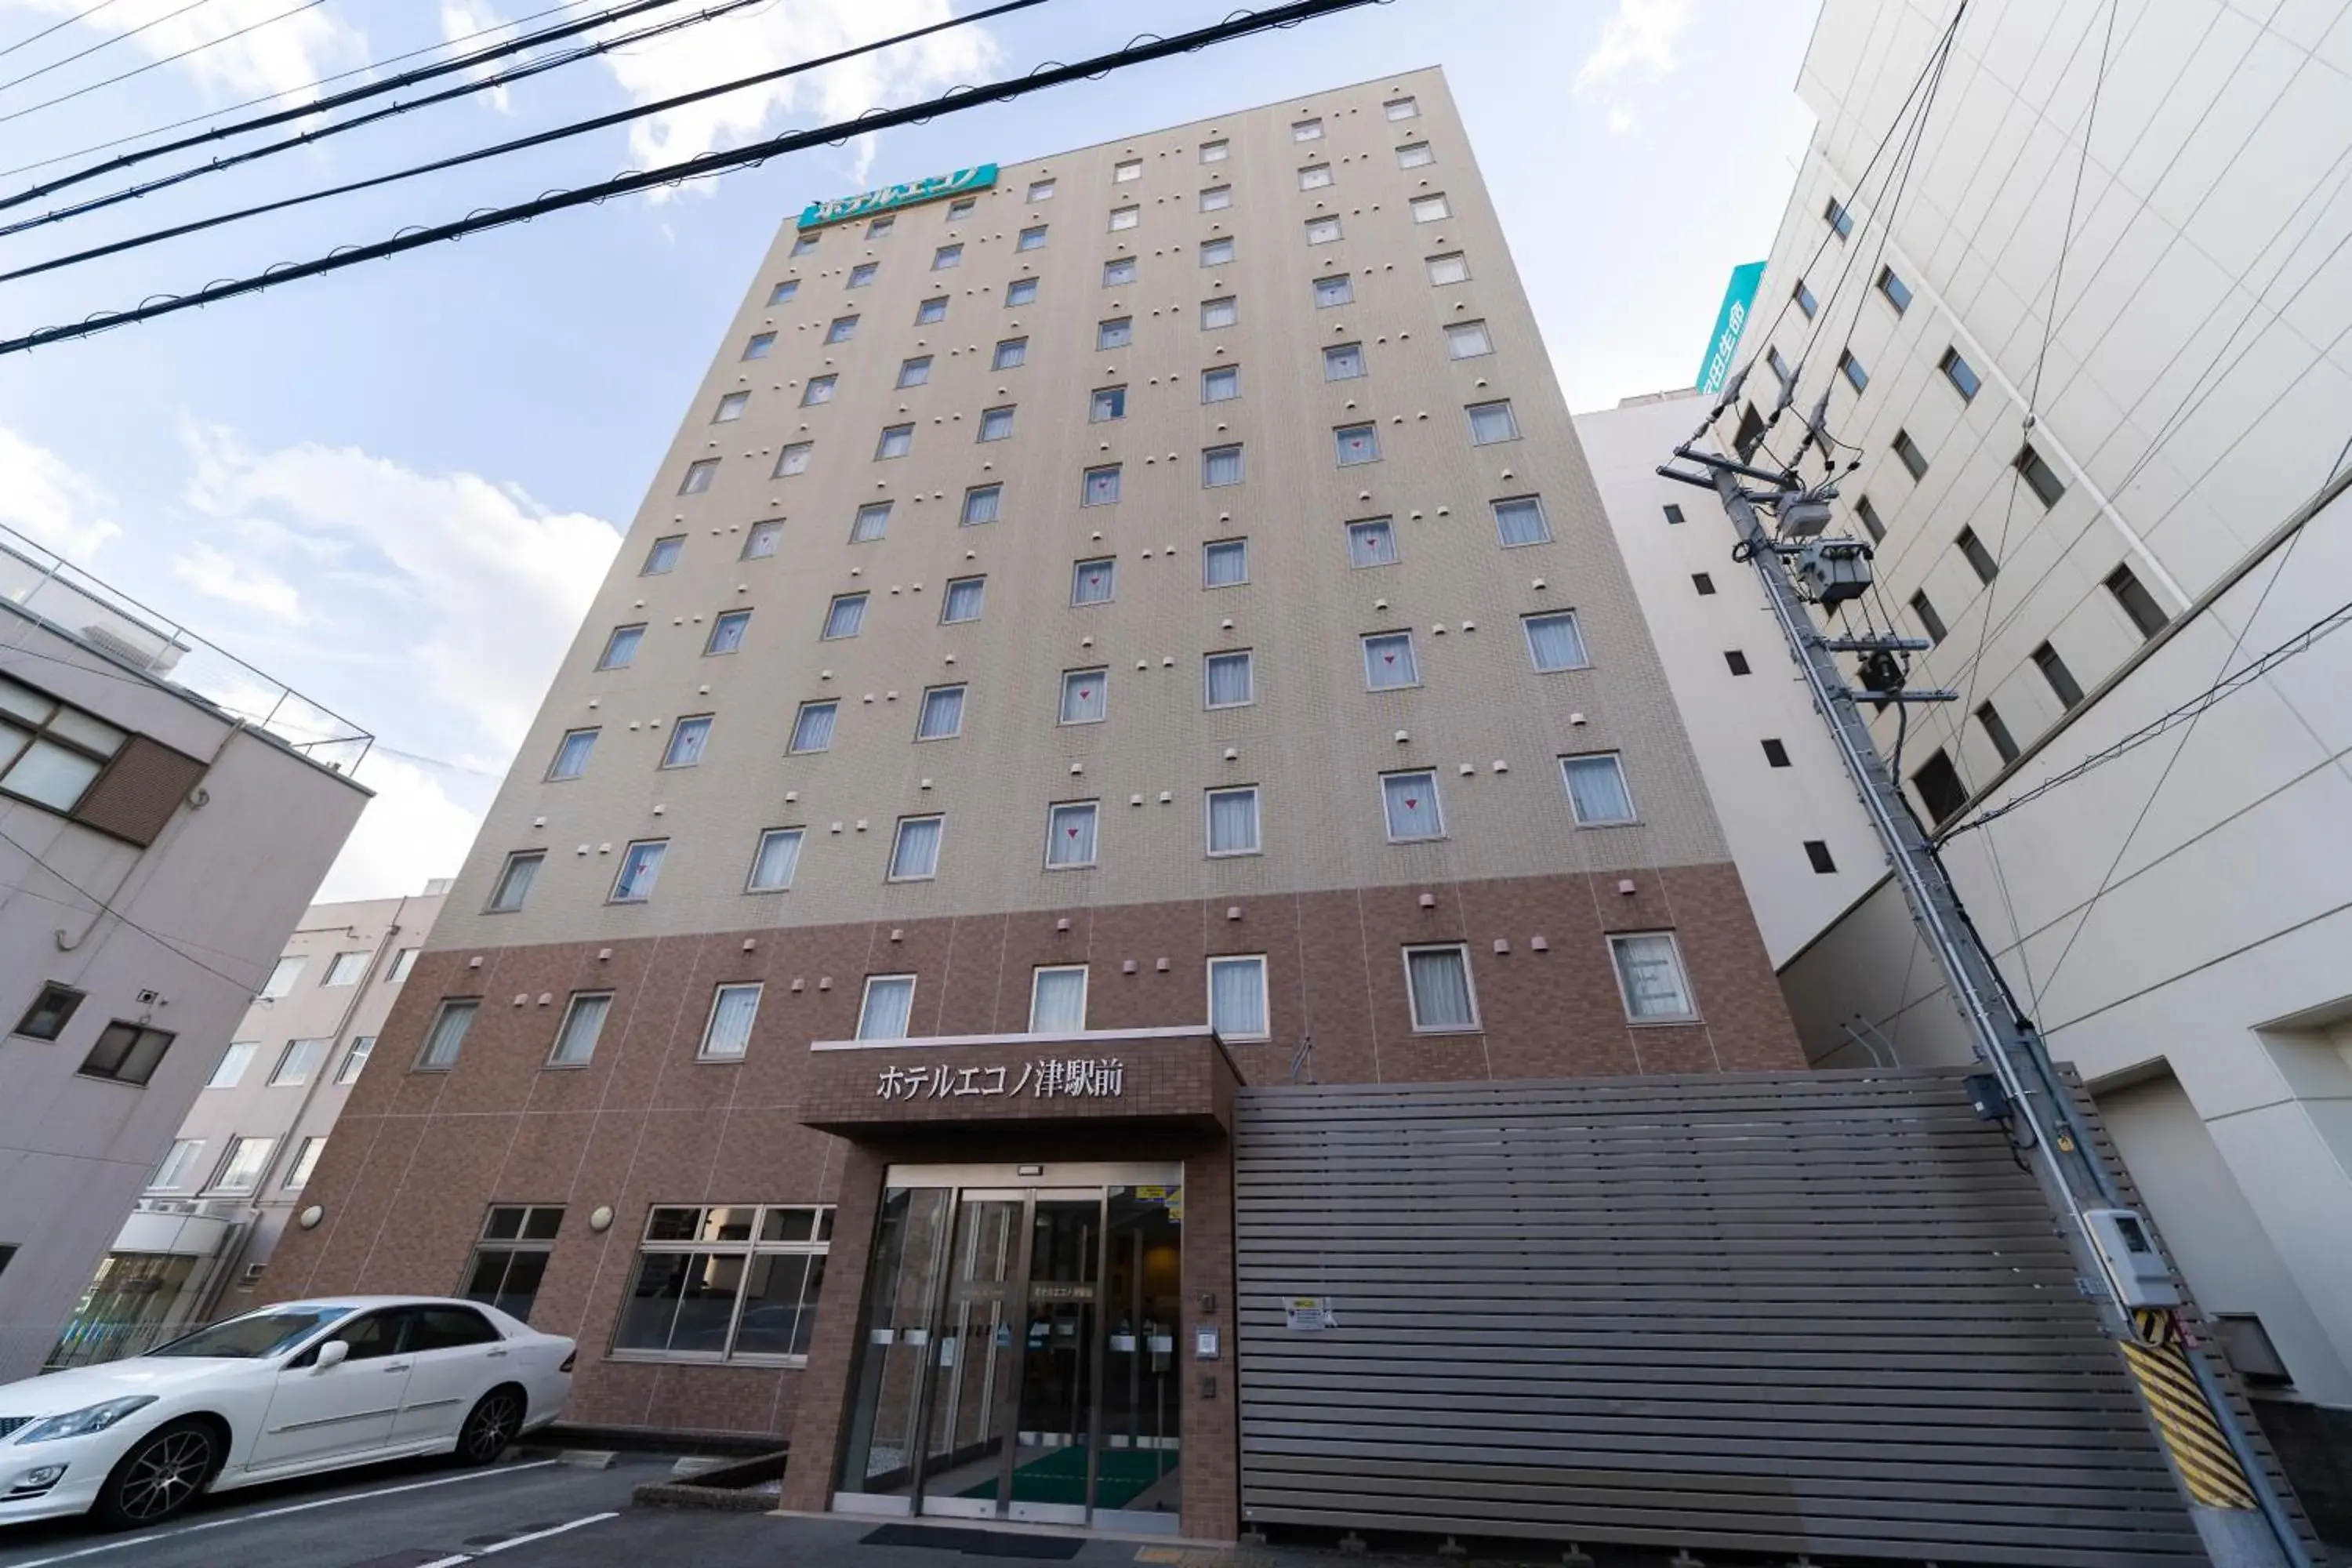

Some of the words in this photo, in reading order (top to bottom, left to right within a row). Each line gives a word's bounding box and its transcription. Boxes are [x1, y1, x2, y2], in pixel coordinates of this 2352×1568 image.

[814, 166, 978, 220] ホテルエコノ
[877, 1058, 1124, 1101] ホテルエコノ津駅前
